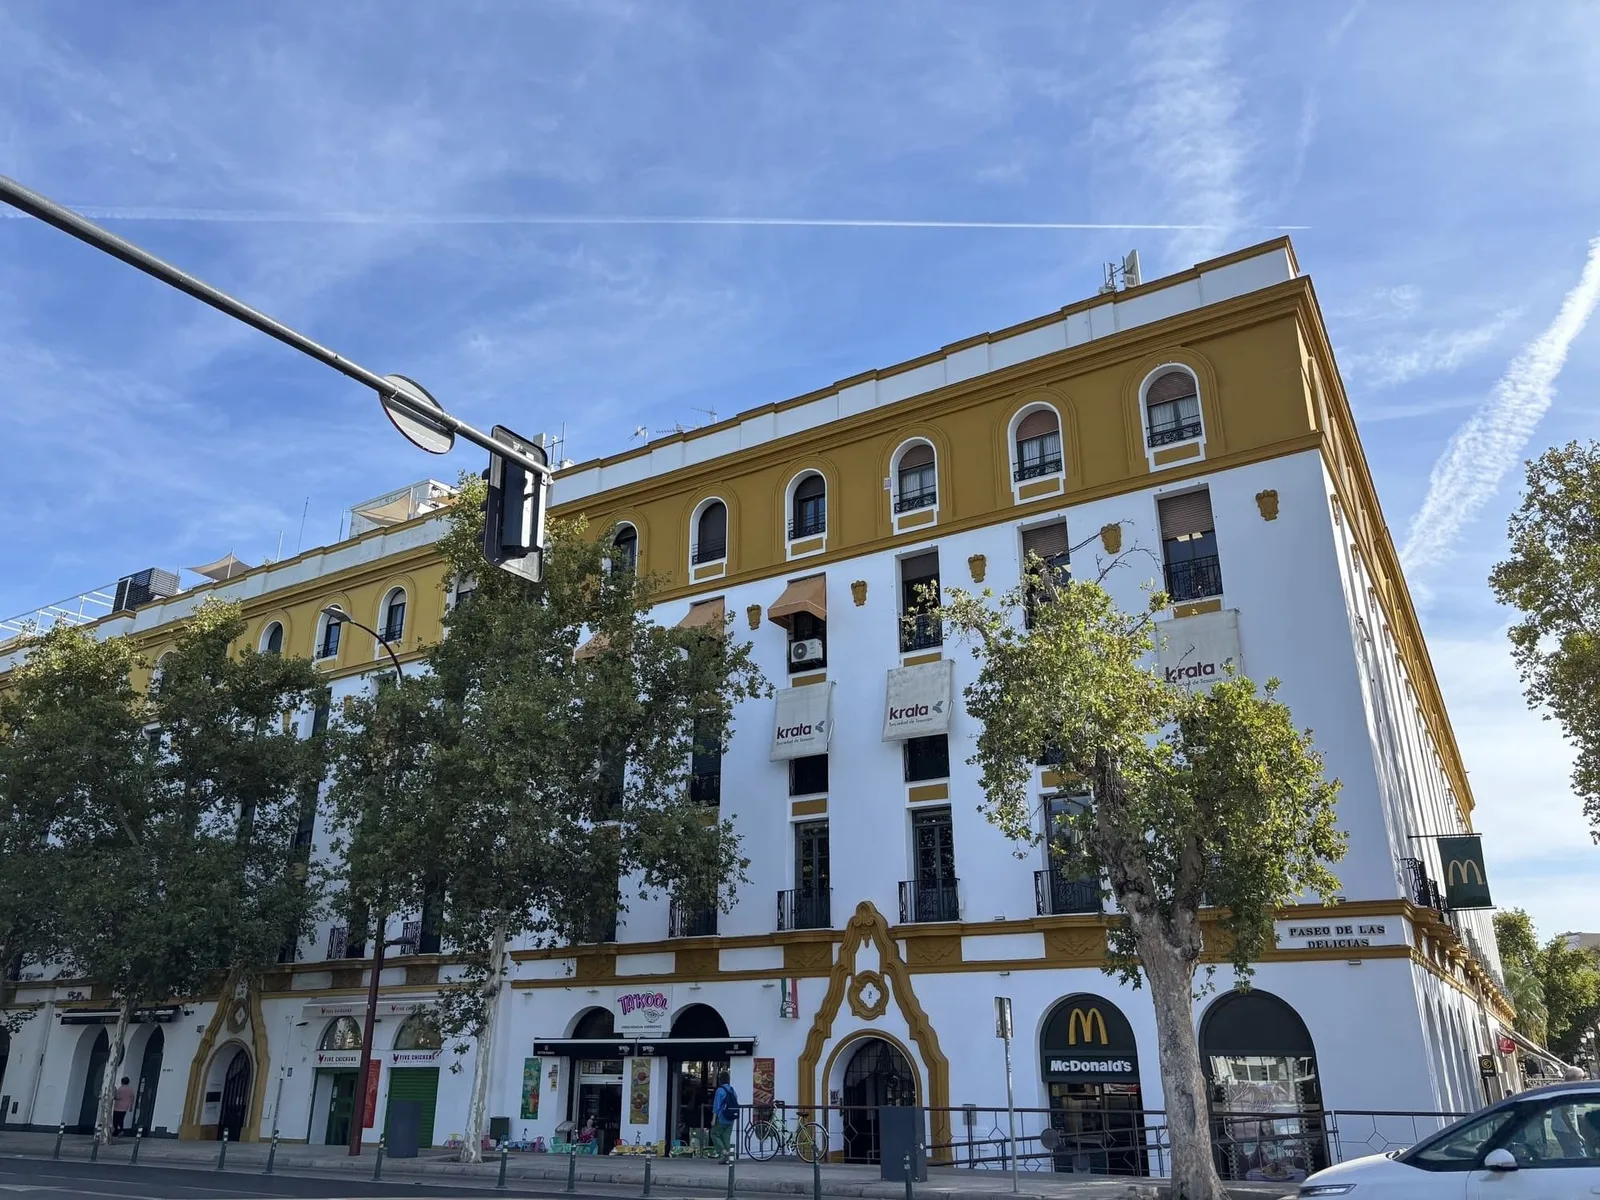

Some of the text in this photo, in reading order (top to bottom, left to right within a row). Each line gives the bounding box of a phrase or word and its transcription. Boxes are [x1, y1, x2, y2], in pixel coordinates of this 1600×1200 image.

[1165, 661, 1215, 683] krata
[889, 703, 929, 720] krata
[777, 722, 812, 740] krata
[1289, 925, 1386, 937] PASEO DE LAS
[1307, 938, 1370, 949] DELICIAS
[324, 1055, 334, 1063] FIVE
[399, 1053, 410, 1061] FIVE
[1050, 1060, 1133, 1073] McDonald's
